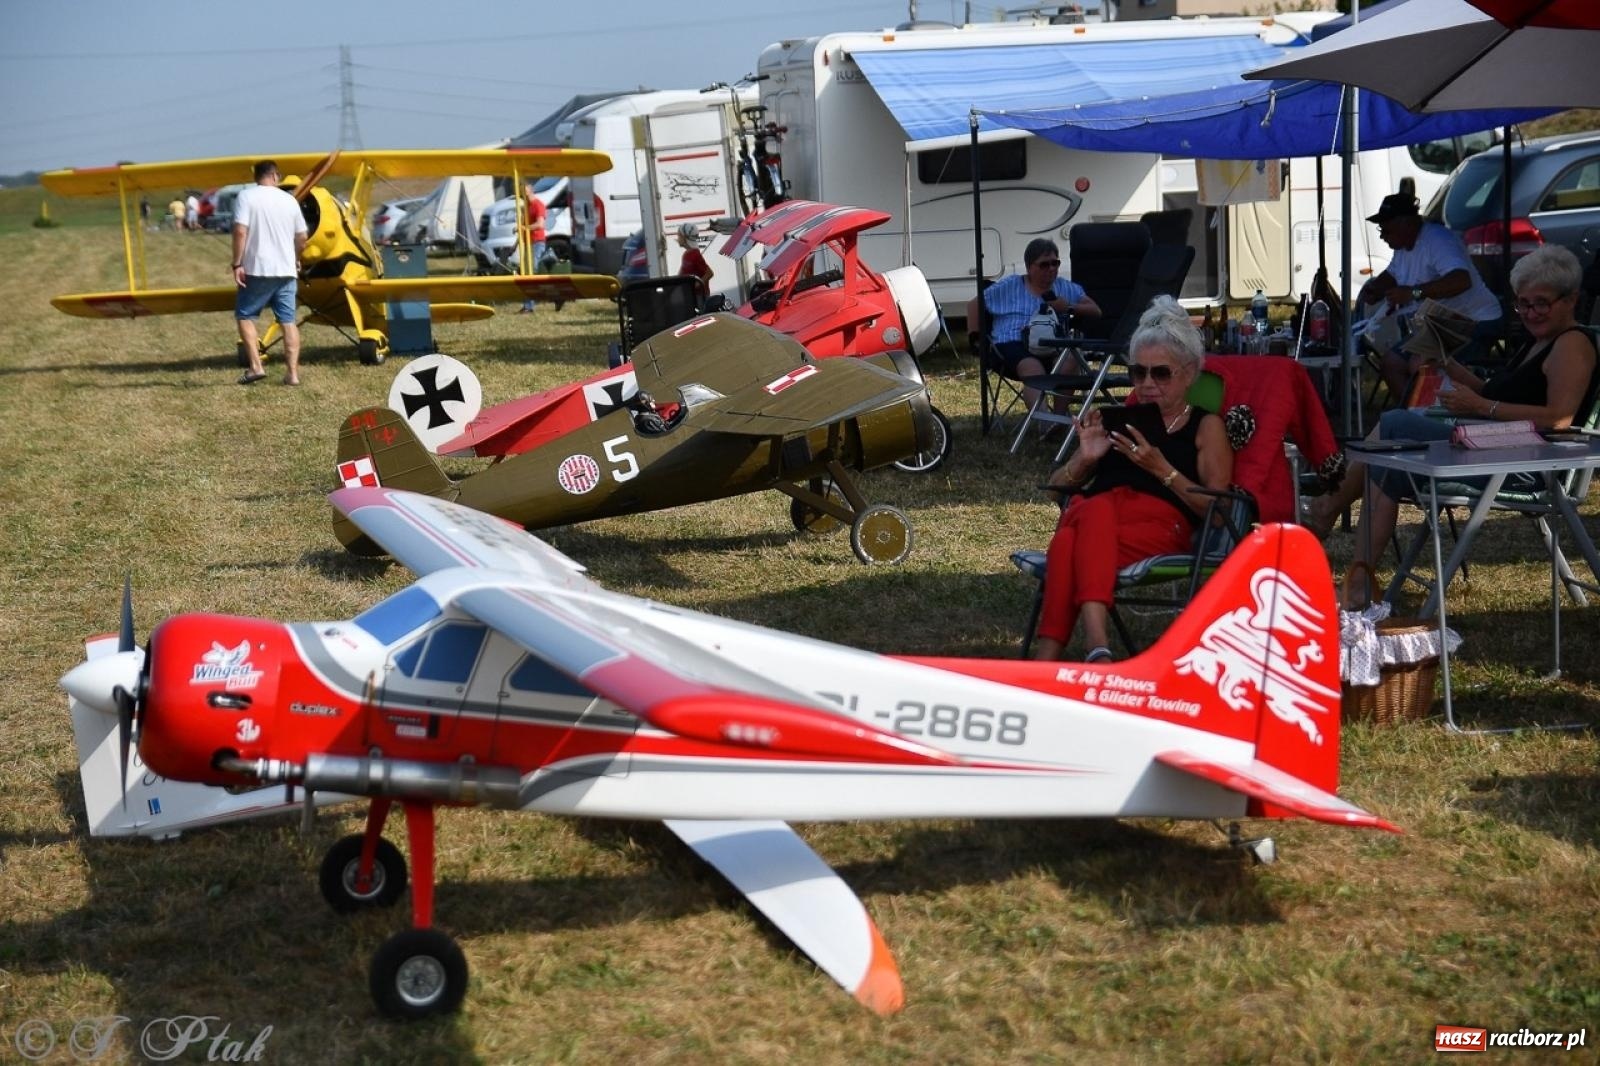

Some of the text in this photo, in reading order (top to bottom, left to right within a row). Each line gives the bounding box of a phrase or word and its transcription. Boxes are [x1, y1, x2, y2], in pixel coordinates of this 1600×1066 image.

[603, 435, 640, 482] 5
[195, 663, 250, 679] Winged
[1056, 668, 1157, 693] RC Air Shows
[1084, 687, 1201, 717] & Glider Towing
